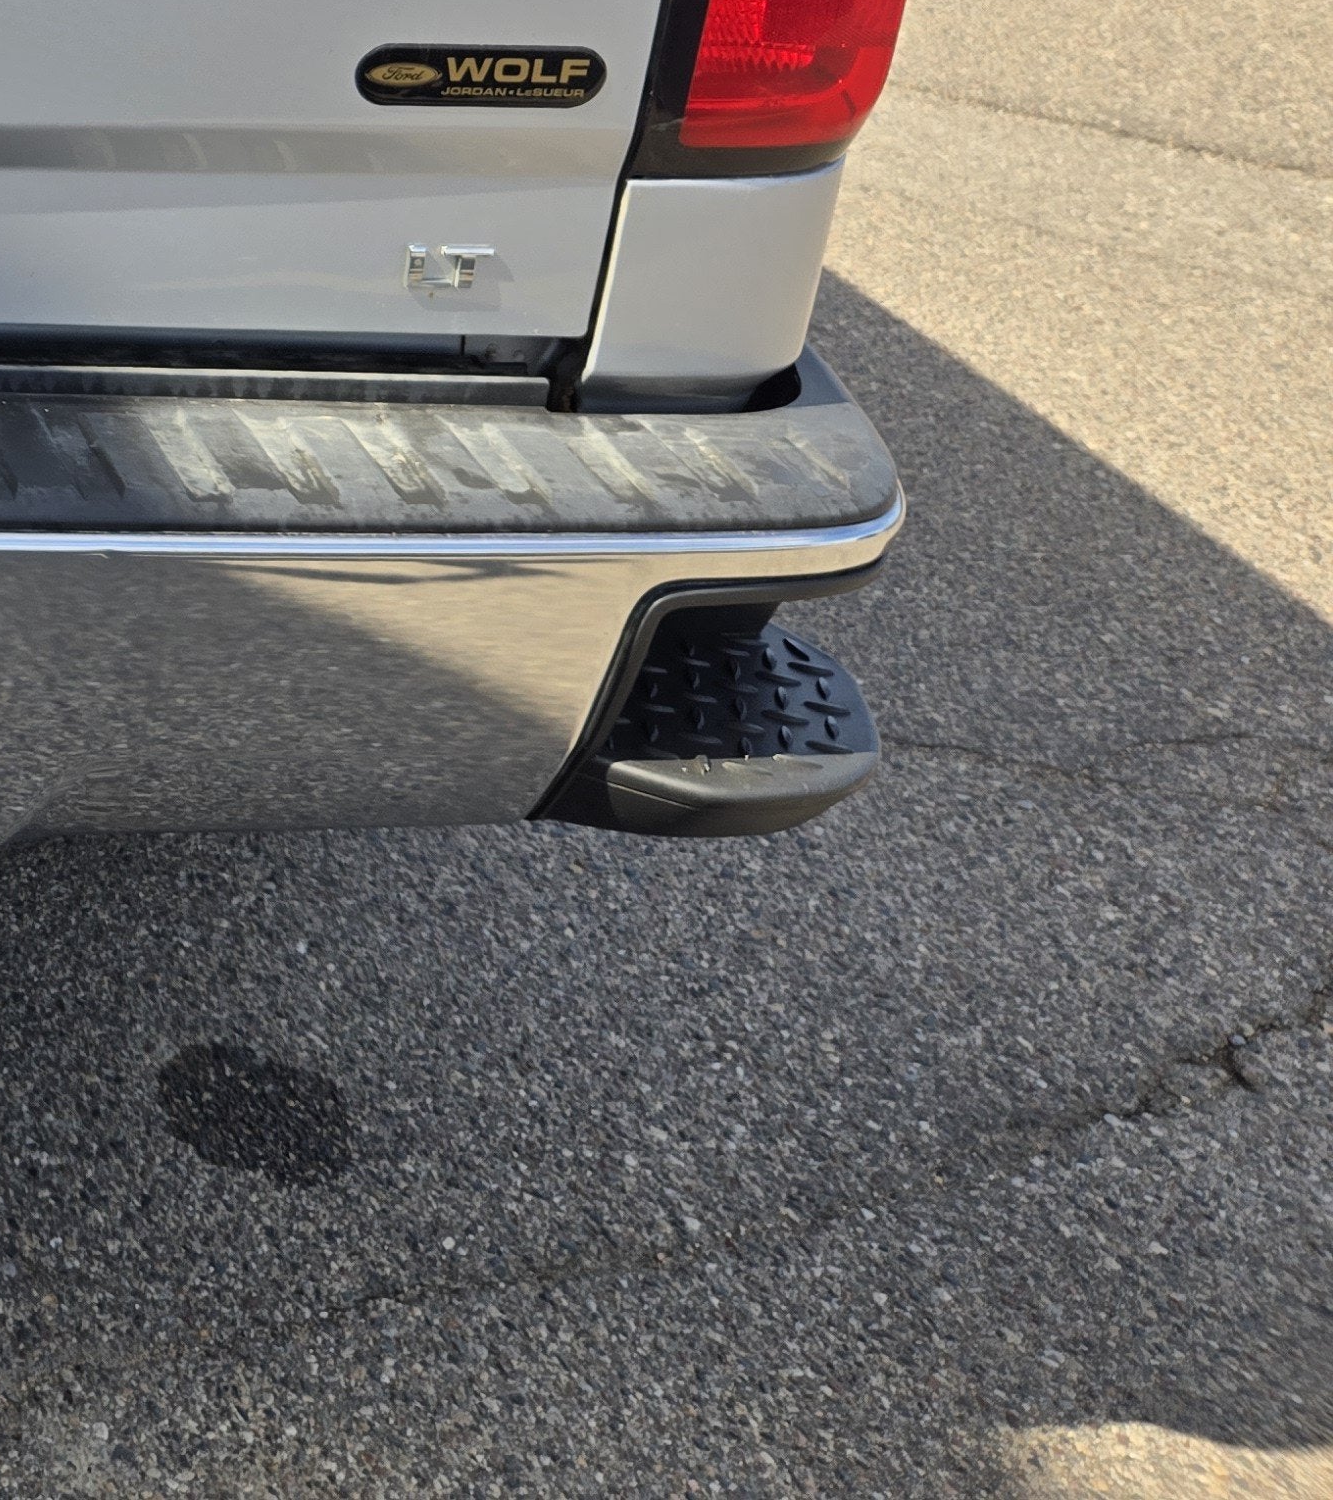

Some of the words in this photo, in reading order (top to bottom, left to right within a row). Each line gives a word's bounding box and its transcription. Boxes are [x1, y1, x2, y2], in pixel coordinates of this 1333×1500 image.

[381, 66, 424, 81] Ford
[447, 57, 591, 84] WOLF
[441, 86, 508, 97] JORDAN
[403, 243, 495, 289] LT
